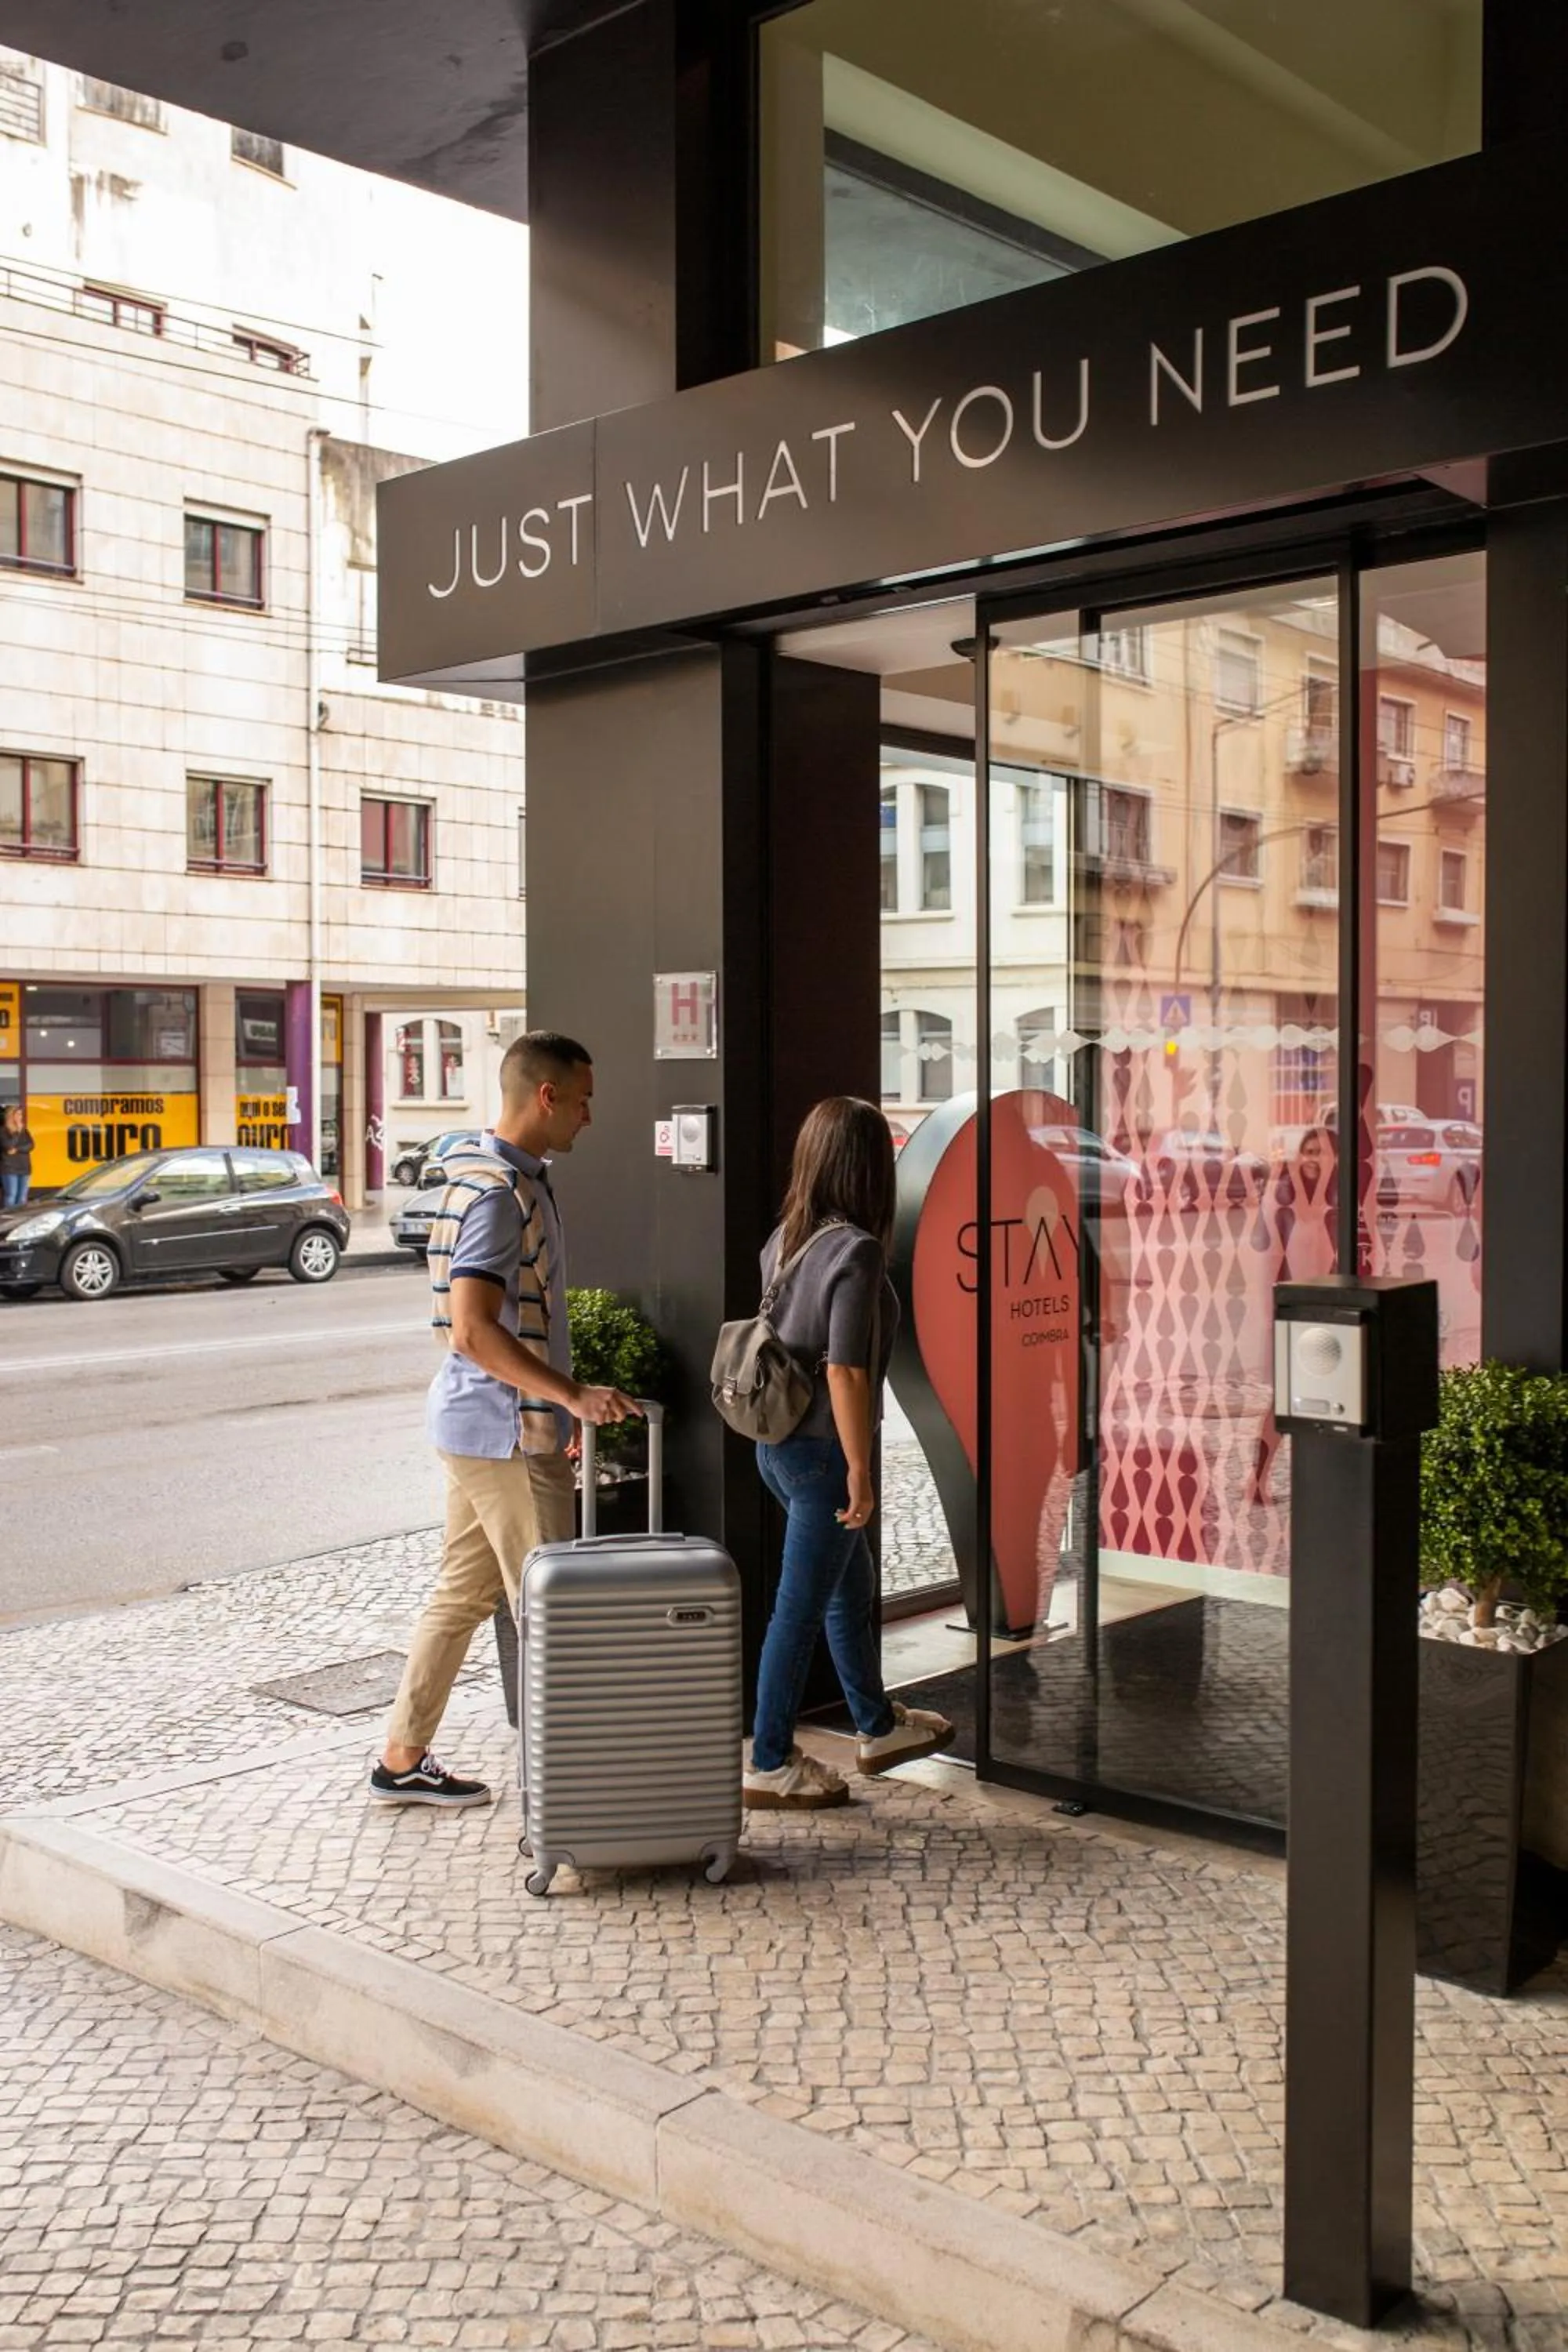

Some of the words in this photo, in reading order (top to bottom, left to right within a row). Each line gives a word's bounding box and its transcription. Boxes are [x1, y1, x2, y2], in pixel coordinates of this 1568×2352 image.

[428, 493, 593, 600] JUST
[625, 422, 856, 548] WHAT
[891, 358, 1091, 483] YOU
[1149, 265, 1469, 426] NEED
[670, 981, 699, 1026] H
[64, 1097, 164, 1116] compramos
[67, 1123, 162, 1163] ouro
[1010, 1294, 1070, 1319] HOTELS
[1022, 1328, 1070, 1348] COIMBRA
